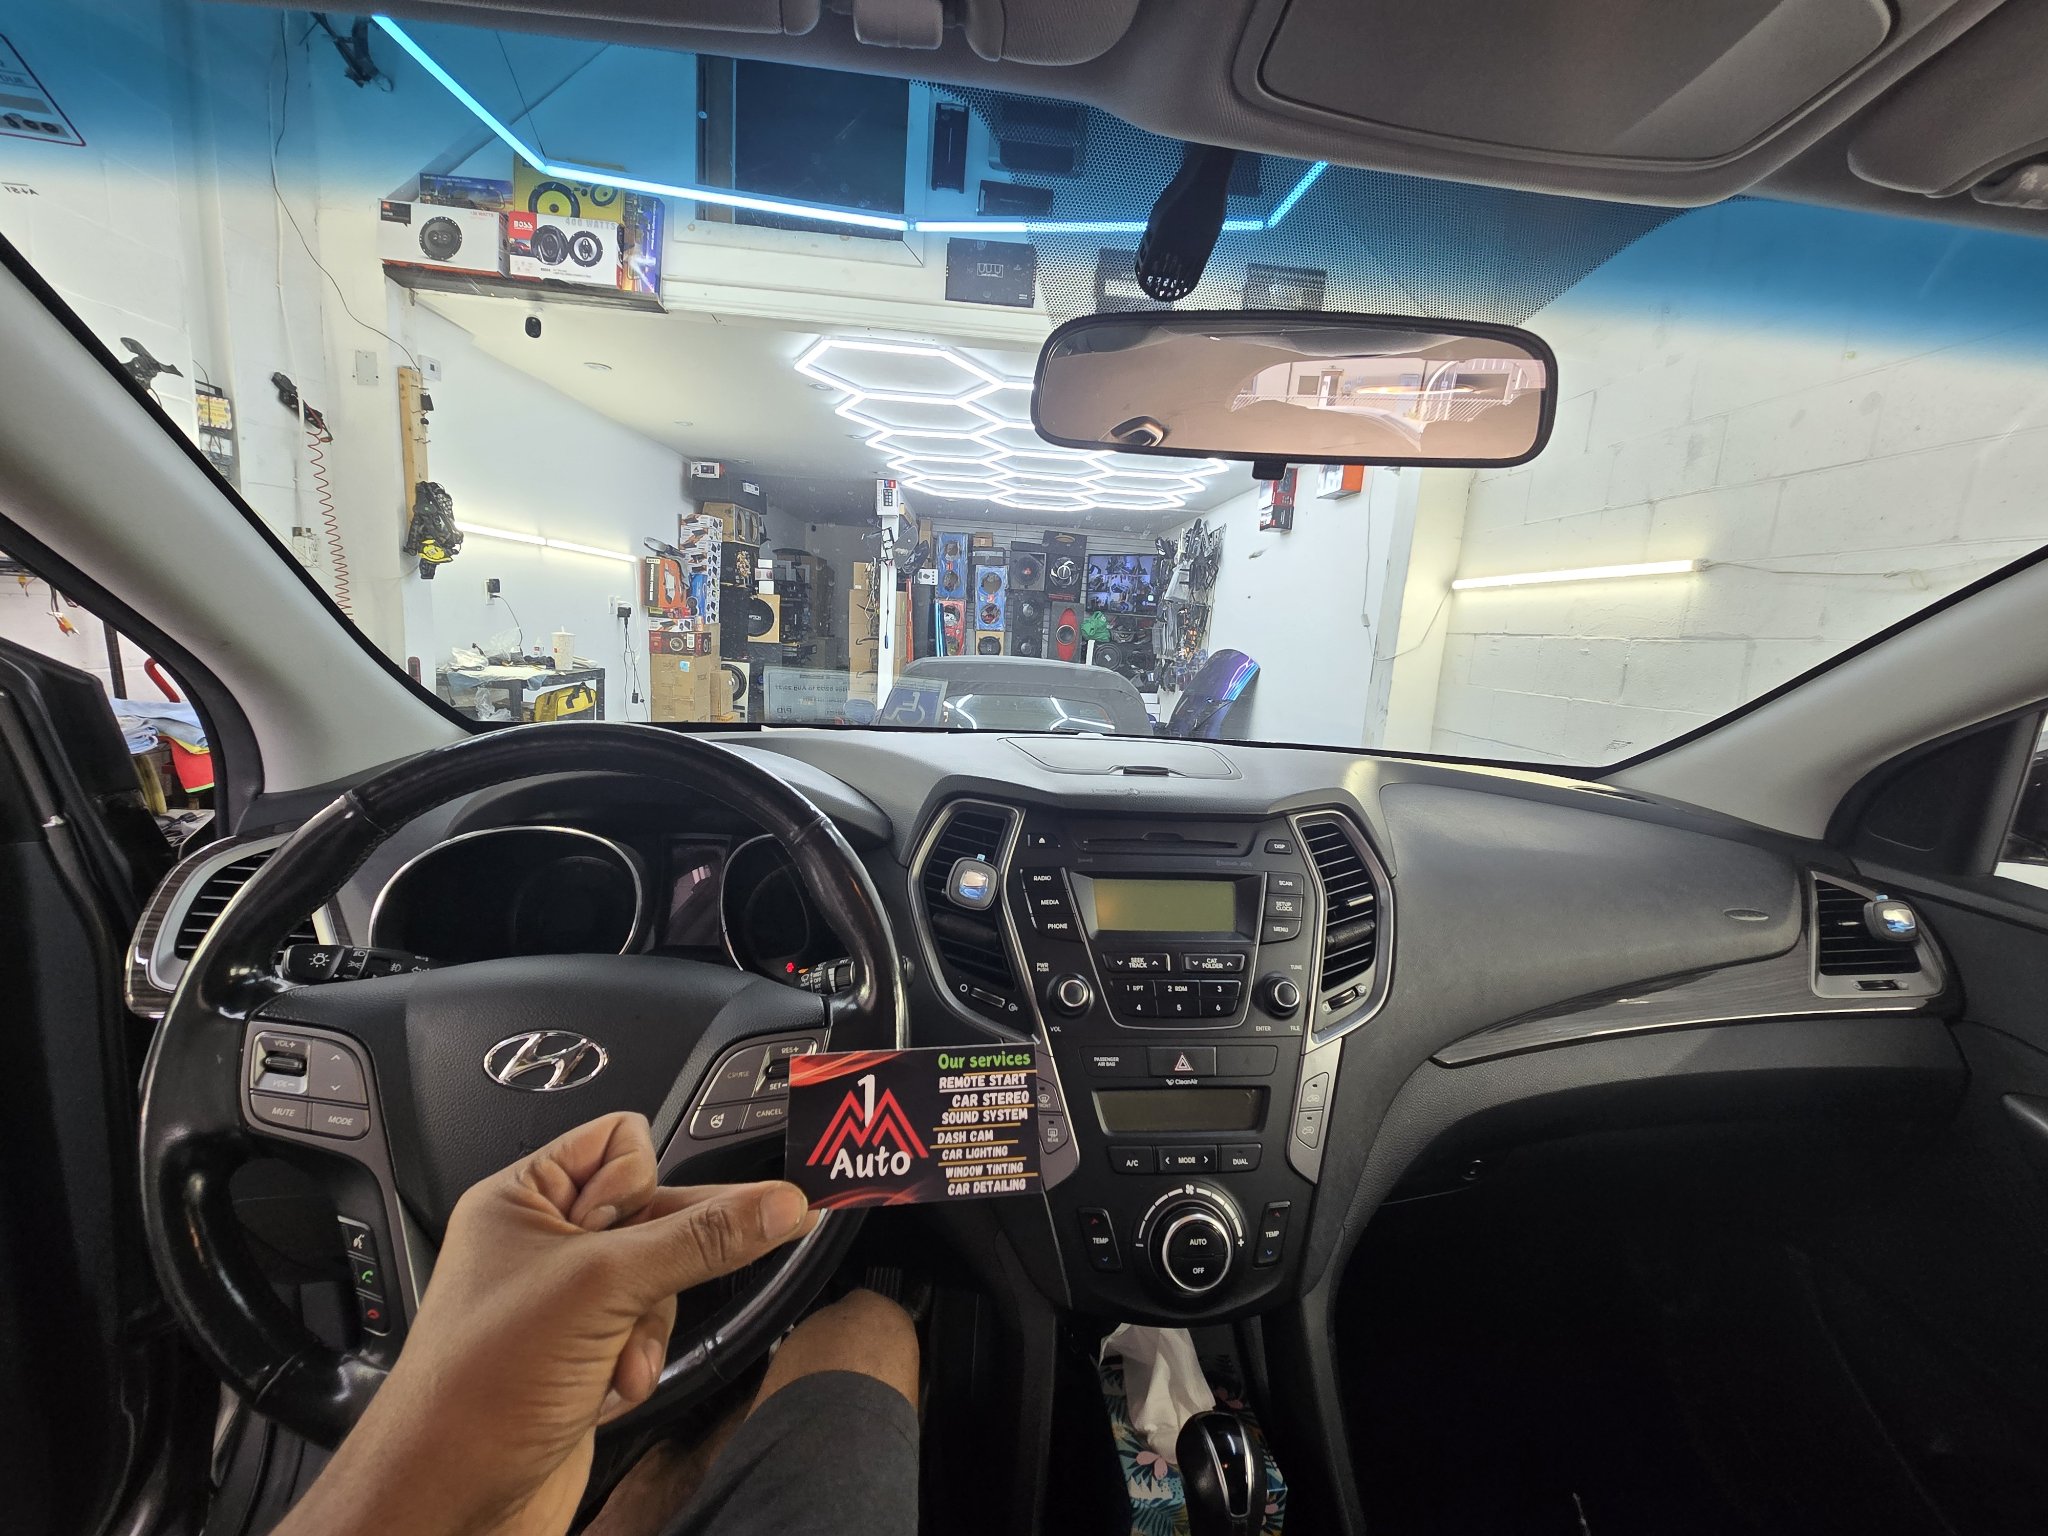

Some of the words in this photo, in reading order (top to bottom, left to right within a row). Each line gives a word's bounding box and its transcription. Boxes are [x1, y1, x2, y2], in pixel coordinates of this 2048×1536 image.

[513, 219, 533, 229] BOSS
[586, 219, 616, 230] WATTS
[1136, 1003, 1142, 1011] 4
[1215, 1003, 1221, 1011] 6
[938, 1053, 965, 1070] Our
[969, 1051, 1031, 1069] services
[939, 1075, 986, 1089] REMOTE
[988, 1073, 1027, 1087] START
[857, 1073, 876, 1128] 1
[951, 1094, 978, 1108] CAR
[983, 1090, 1030, 1106] STEREO
[271, 1106, 296, 1117] MUTE
[756, 1108, 783, 1118] CANCEL
[941, 1111, 979, 1125] SOUND
[983, 1107, 1028, 1122] SYSTEM
[327, 1115, 354, 1126] MODE
[937, 1131, 967, 1145] DASH
[970, 1129, 994, 1142] CAM
[942, 1149, 963, 1161] CAR
[965, 1145, 1008, 1159] LIGHTING
[830, 1145, 911, 1180] Auto
[1126, 1159, 1139, 1167] A/C
[1178, 1156, 1196, 1164] MODE
[1232, 1158, 1249, 1166] DUAL
[945, 1166, 984, 1179] WINDOW
[986, 1162, 1024, 1176] TINTING
[947, 1183, 971, 1196] CAR
[972, 1178, 1027, 1194] DETAILING
[1265, 1230, 1280, 1238] TEMP
[1092, 1237, 1109, 1245] TEMP
[1189, 1238, 1208, 1246] AUTO
[1192, 1266, 1205, 1275] OFF
